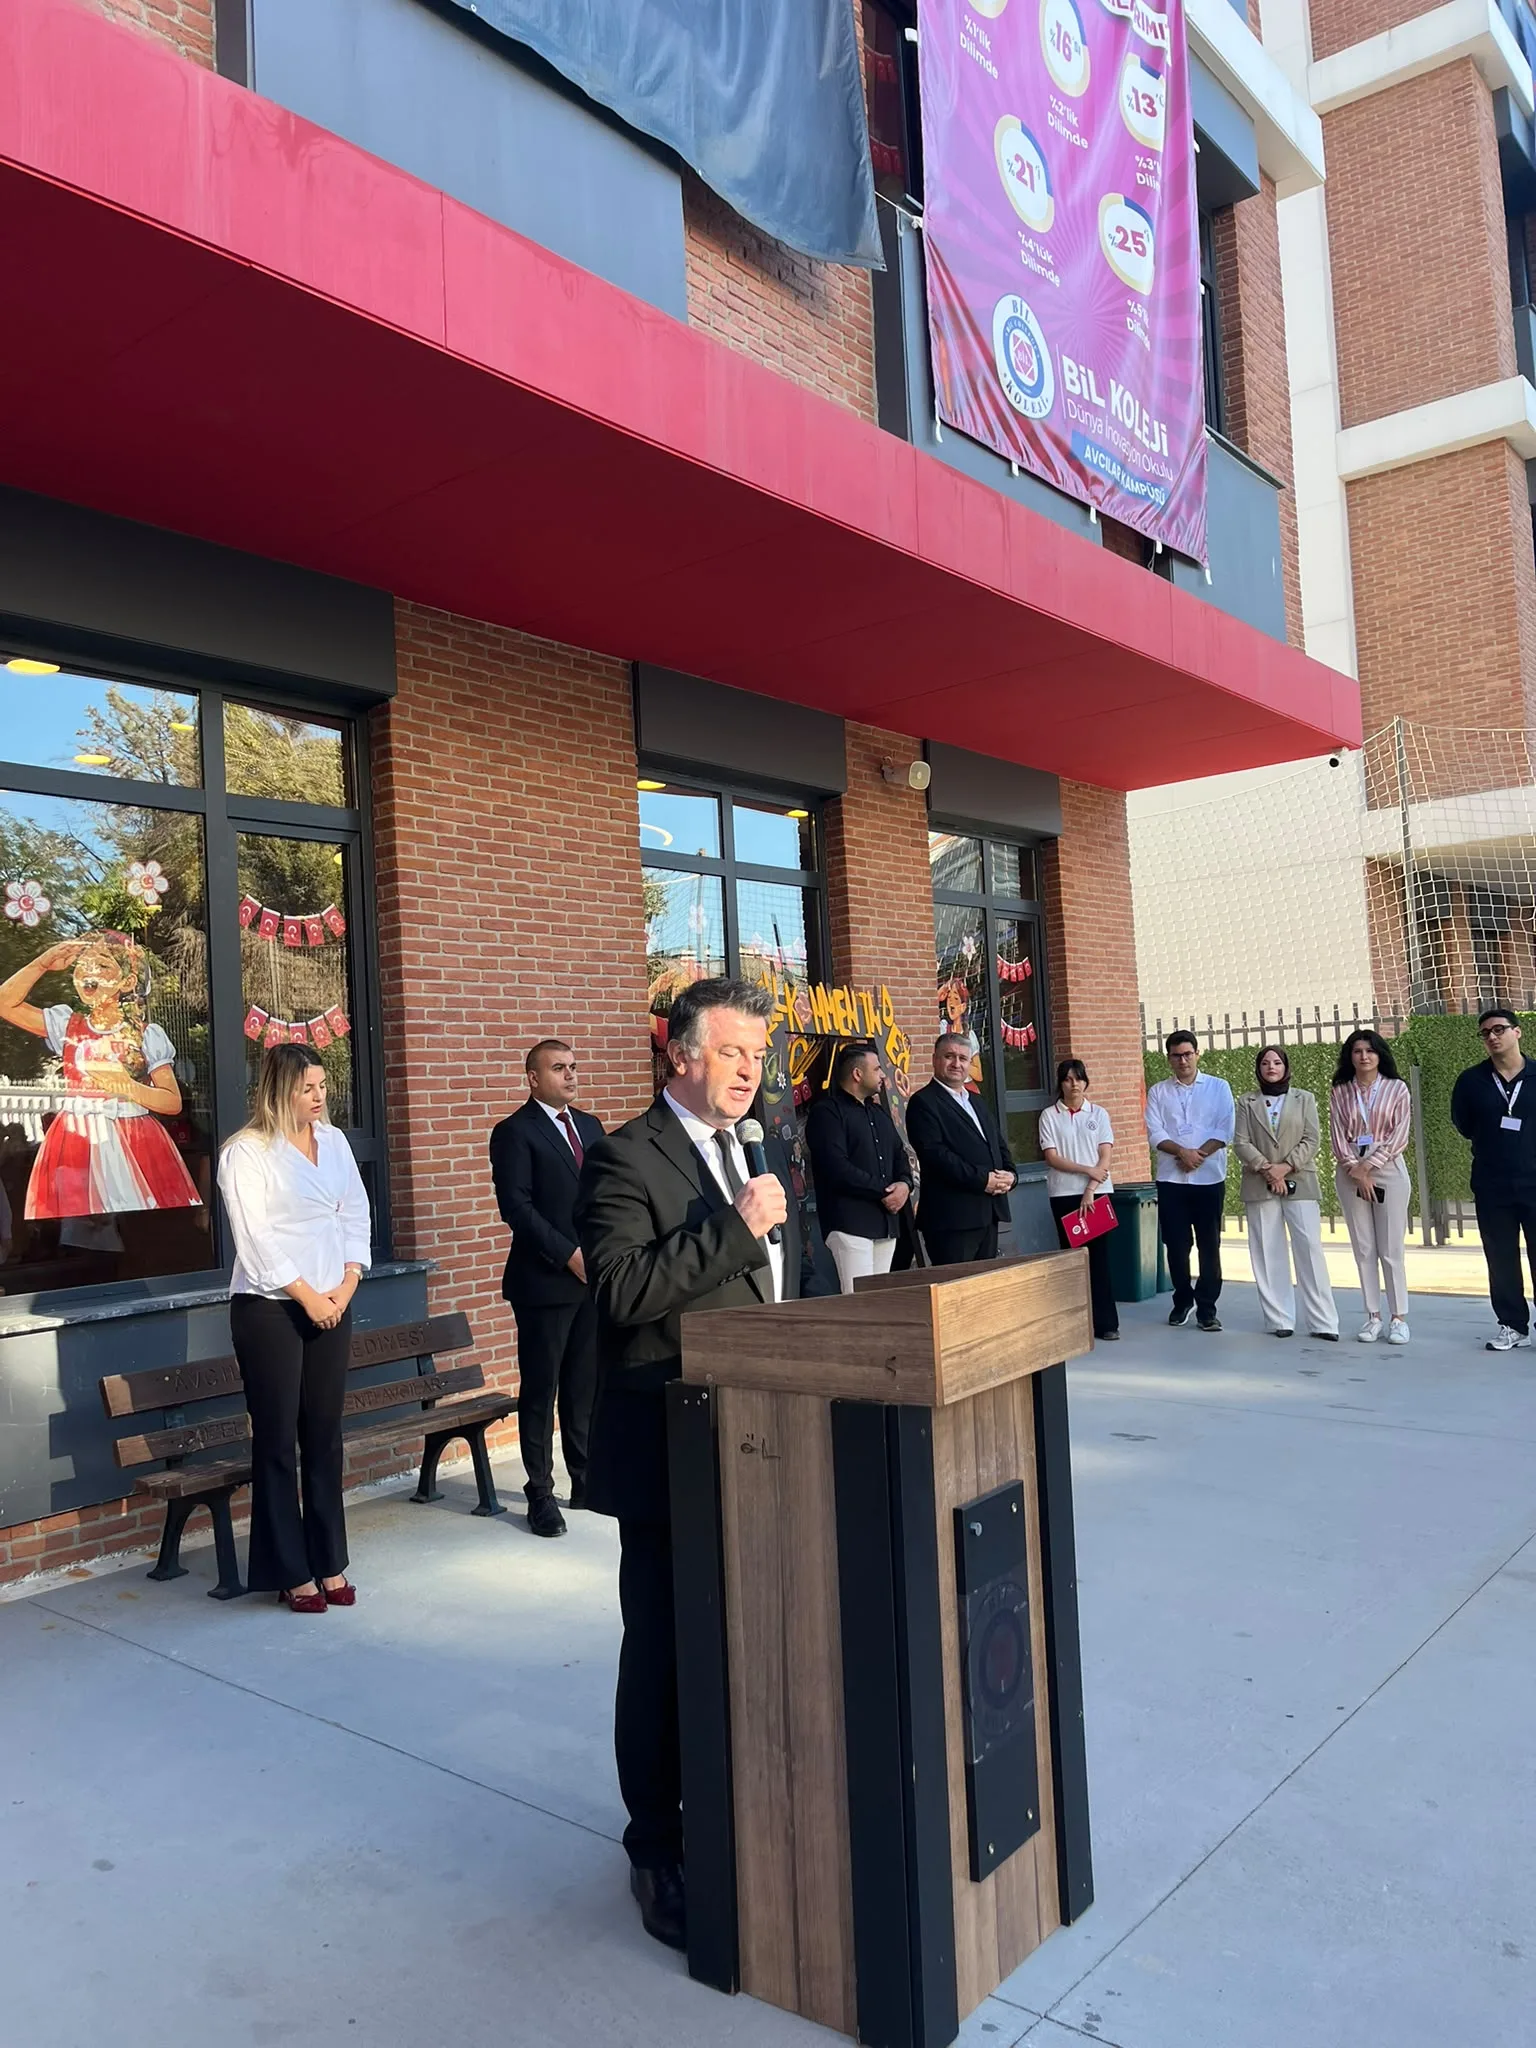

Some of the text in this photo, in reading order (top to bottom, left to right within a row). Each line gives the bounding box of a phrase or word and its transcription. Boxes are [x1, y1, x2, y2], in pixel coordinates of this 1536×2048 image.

[960, 32, 999, 80] Dilimde
[1047, 111, 1089, 149] Dilimde
[1020, 249, 1060, 287] Dilimde
[1067, 398, 1103, 435] Dünya
[1142, 453, 1174, 482] Okulu
[1084, 444, 1165, 506] AVCILAR KAMPÜSÜ
[174, 1364, 242, 1393] AVCIL
